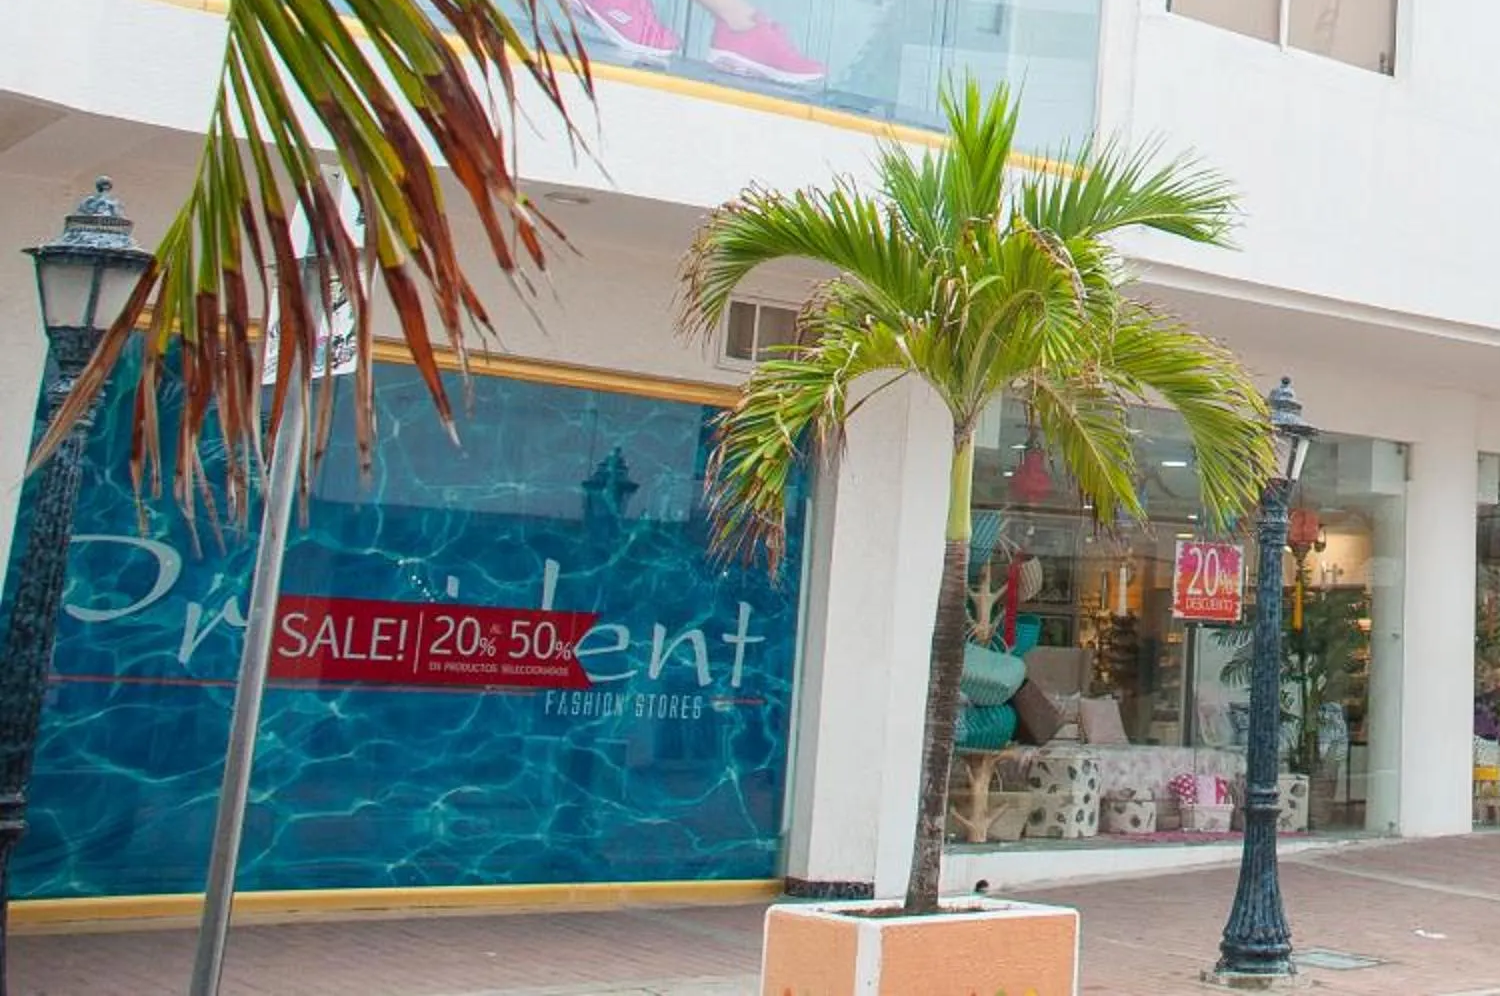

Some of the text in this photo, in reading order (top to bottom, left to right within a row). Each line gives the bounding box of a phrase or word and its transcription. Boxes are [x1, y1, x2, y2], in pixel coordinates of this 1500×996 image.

[277, 612, 408, 661] SALE!
[428, 615, 497, 657] 20%
[507, 619, 574, 661] 50%
[544, 691, 703, 720] FASHION STORES
